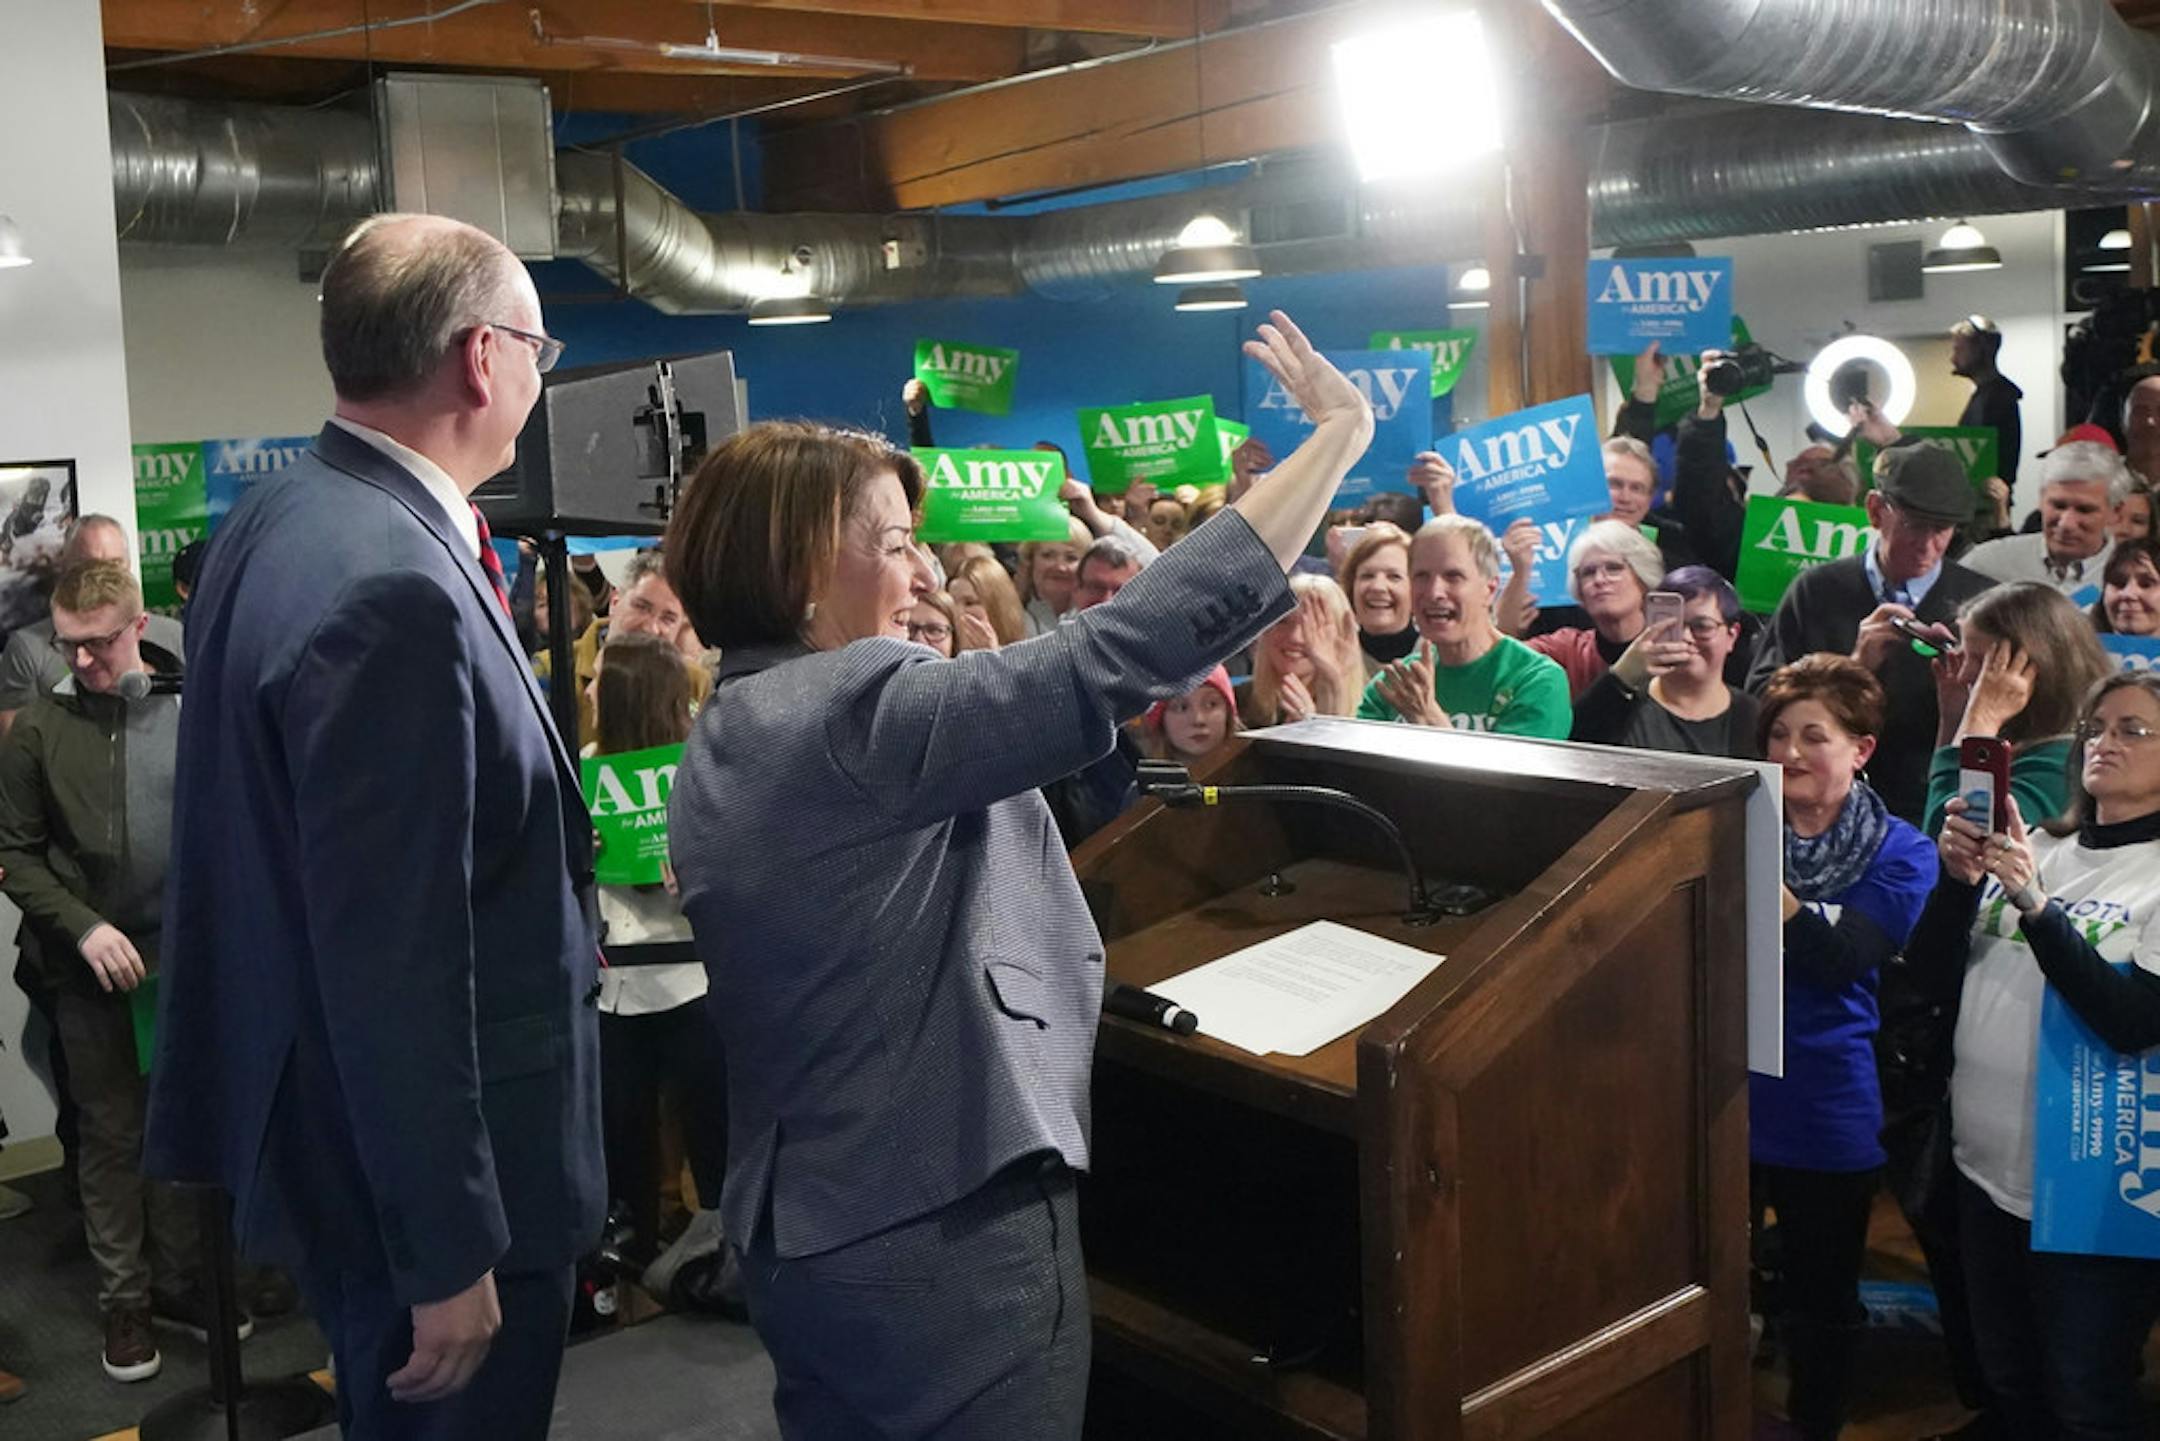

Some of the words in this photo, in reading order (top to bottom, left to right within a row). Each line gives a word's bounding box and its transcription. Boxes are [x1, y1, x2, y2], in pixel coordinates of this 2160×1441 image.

[1596, 264, 1723, 312] Amy
[921, 344, 1011, 385] Amy
[1091, 409, 1205, 449] Amy
[1454, 413, 1581, 487] Amy
[927, 453, 1053, 499] Amy
[1483, 462, 1547, 492] AMERICA
